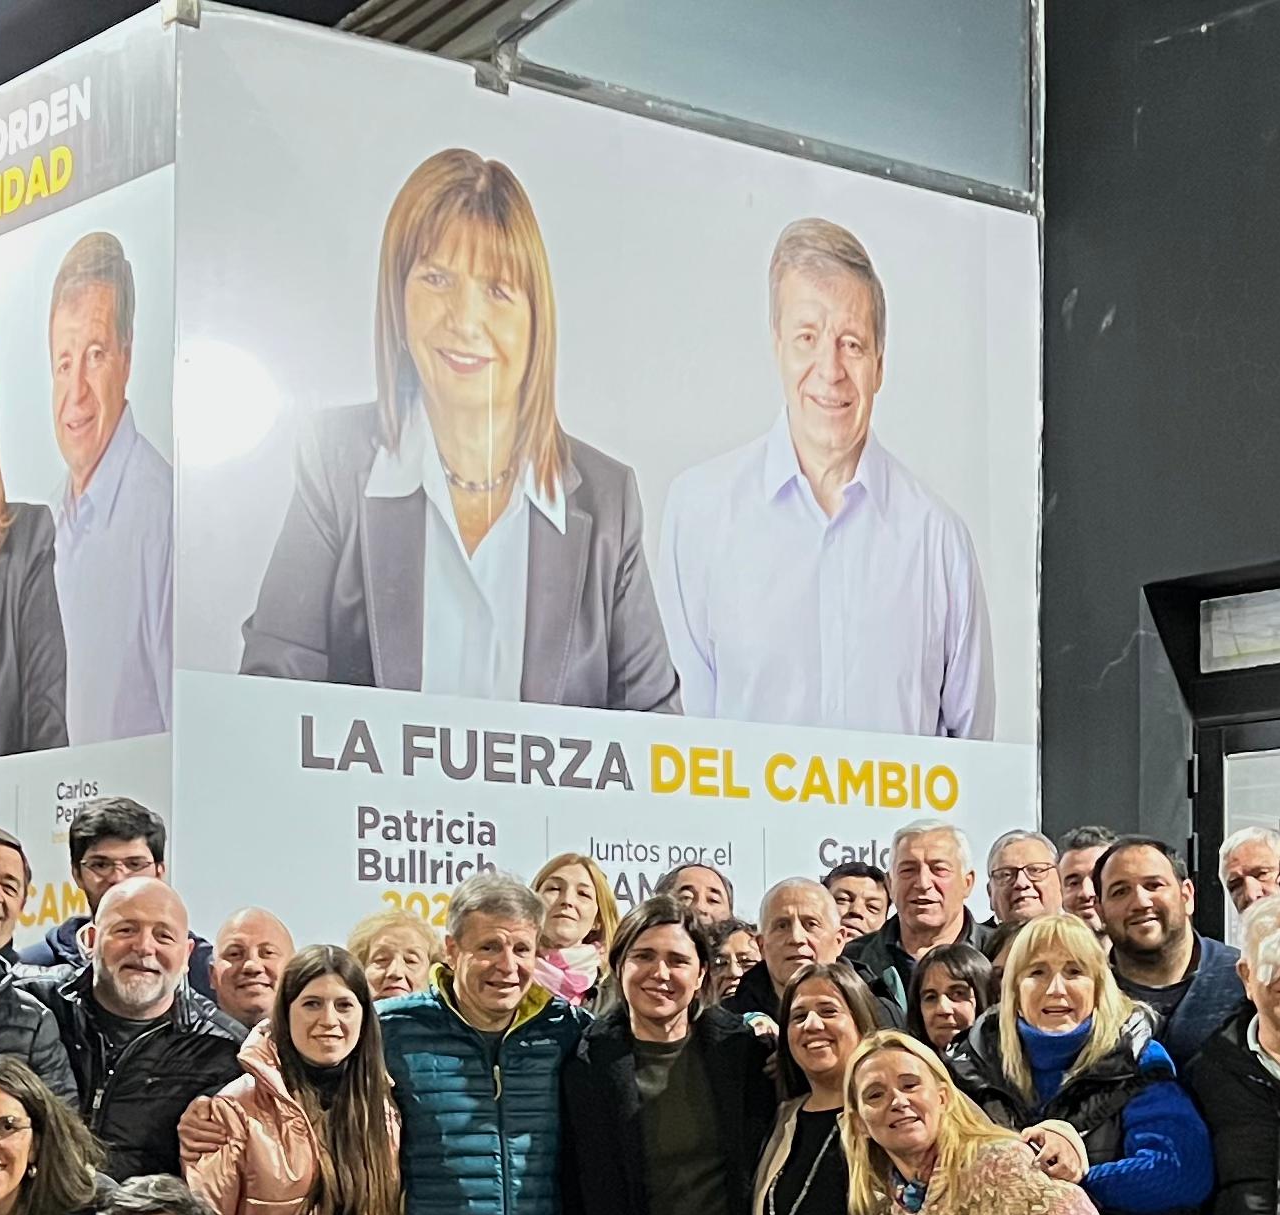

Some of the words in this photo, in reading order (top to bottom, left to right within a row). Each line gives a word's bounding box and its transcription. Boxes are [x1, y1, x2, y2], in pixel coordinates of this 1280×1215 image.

[301, 714, 383, 774] LA
[402, 724, 634, 792] FUERZA
[651, 743, 751, 800] DEL
[765, 752, 959, 812] CAMBIO
[56, 778, 99, 800] Carlos
[358, 806, 497, 847] Patricia
[358, 848, 497, 885] Bullrich
[589, 836, 661, 863] Juntos
[668, 844, 708, 869] por
[713, 841, 733, 867] el
[818, 838, 891, 870] Carlo
[381, 890, 450, 926] 202
